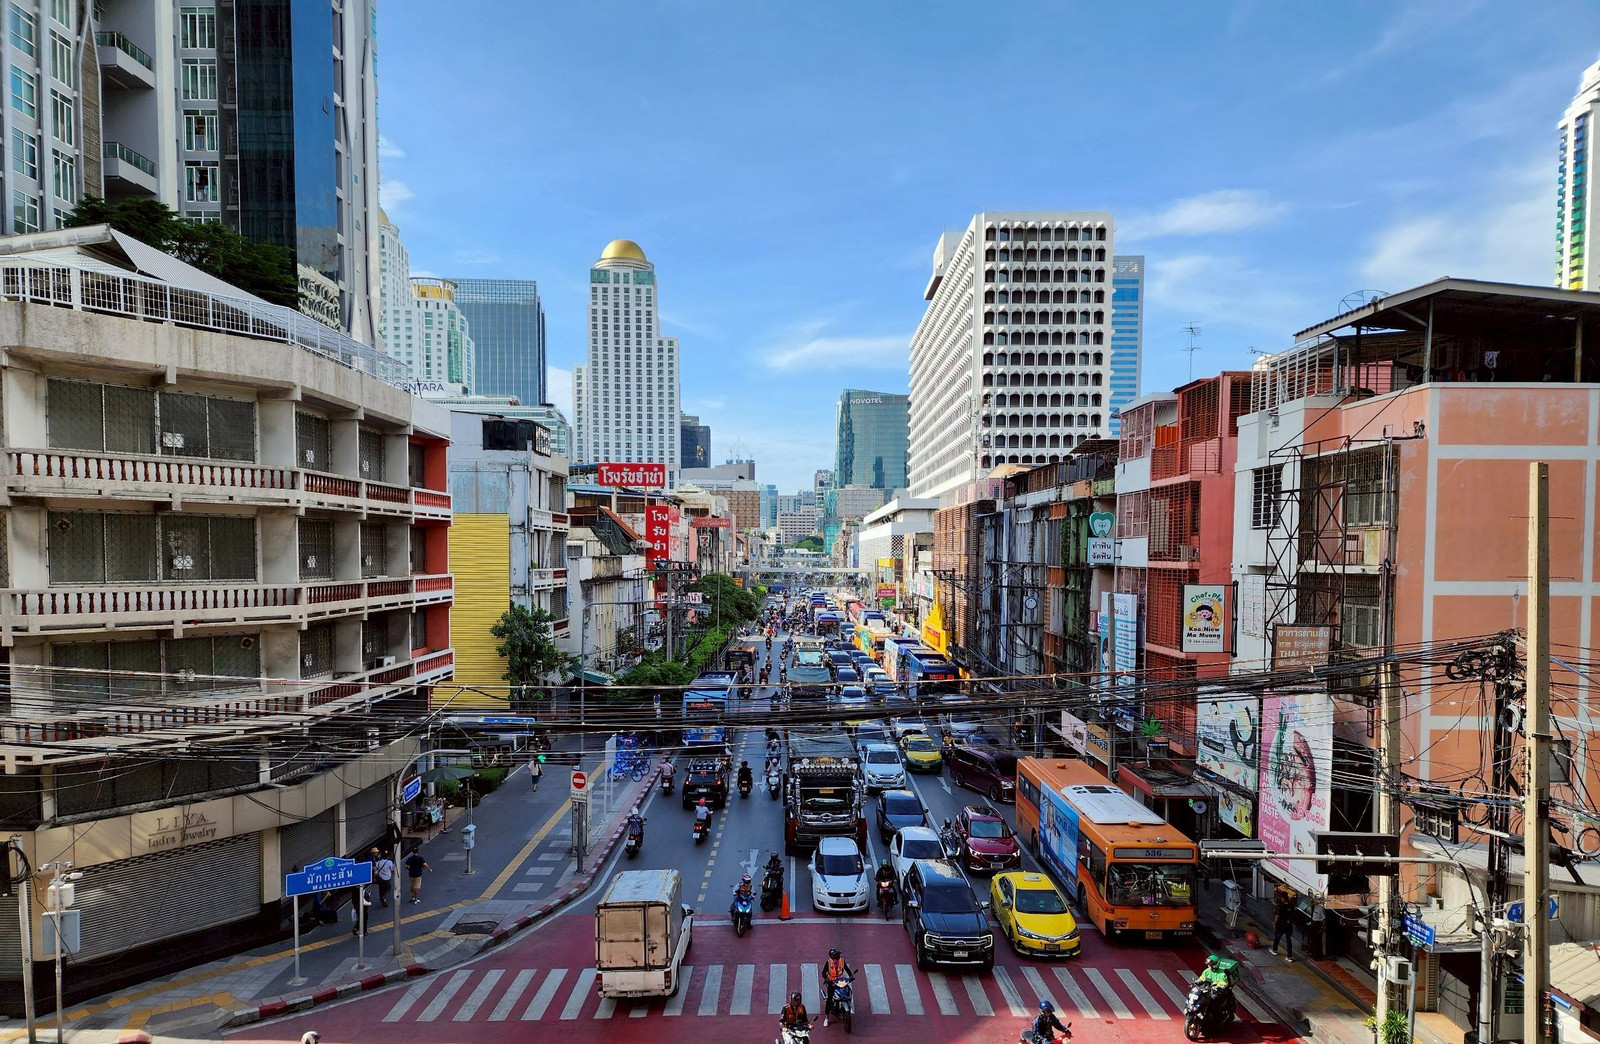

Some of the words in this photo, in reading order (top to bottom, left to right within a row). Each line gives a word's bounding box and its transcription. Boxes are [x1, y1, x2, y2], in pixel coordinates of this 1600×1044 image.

[600, 465, 664, 484] โรงรับจำนำ
[651, 510, 668, 521] โรง
[653, 526, 667, 536] รับ
[1092, 541, 1111, 549] ทำฟัน
[1092, 552, 1111, 560] จัดฟัน
[1191, 592, 1208, 602] Chef
[157, 811, 209, 831] LIYA
[1145, 849, 1162, 857] 536
[307, 867, 353, 885] มักกะสัน
[312, 880, 351, 890] Makkasan
